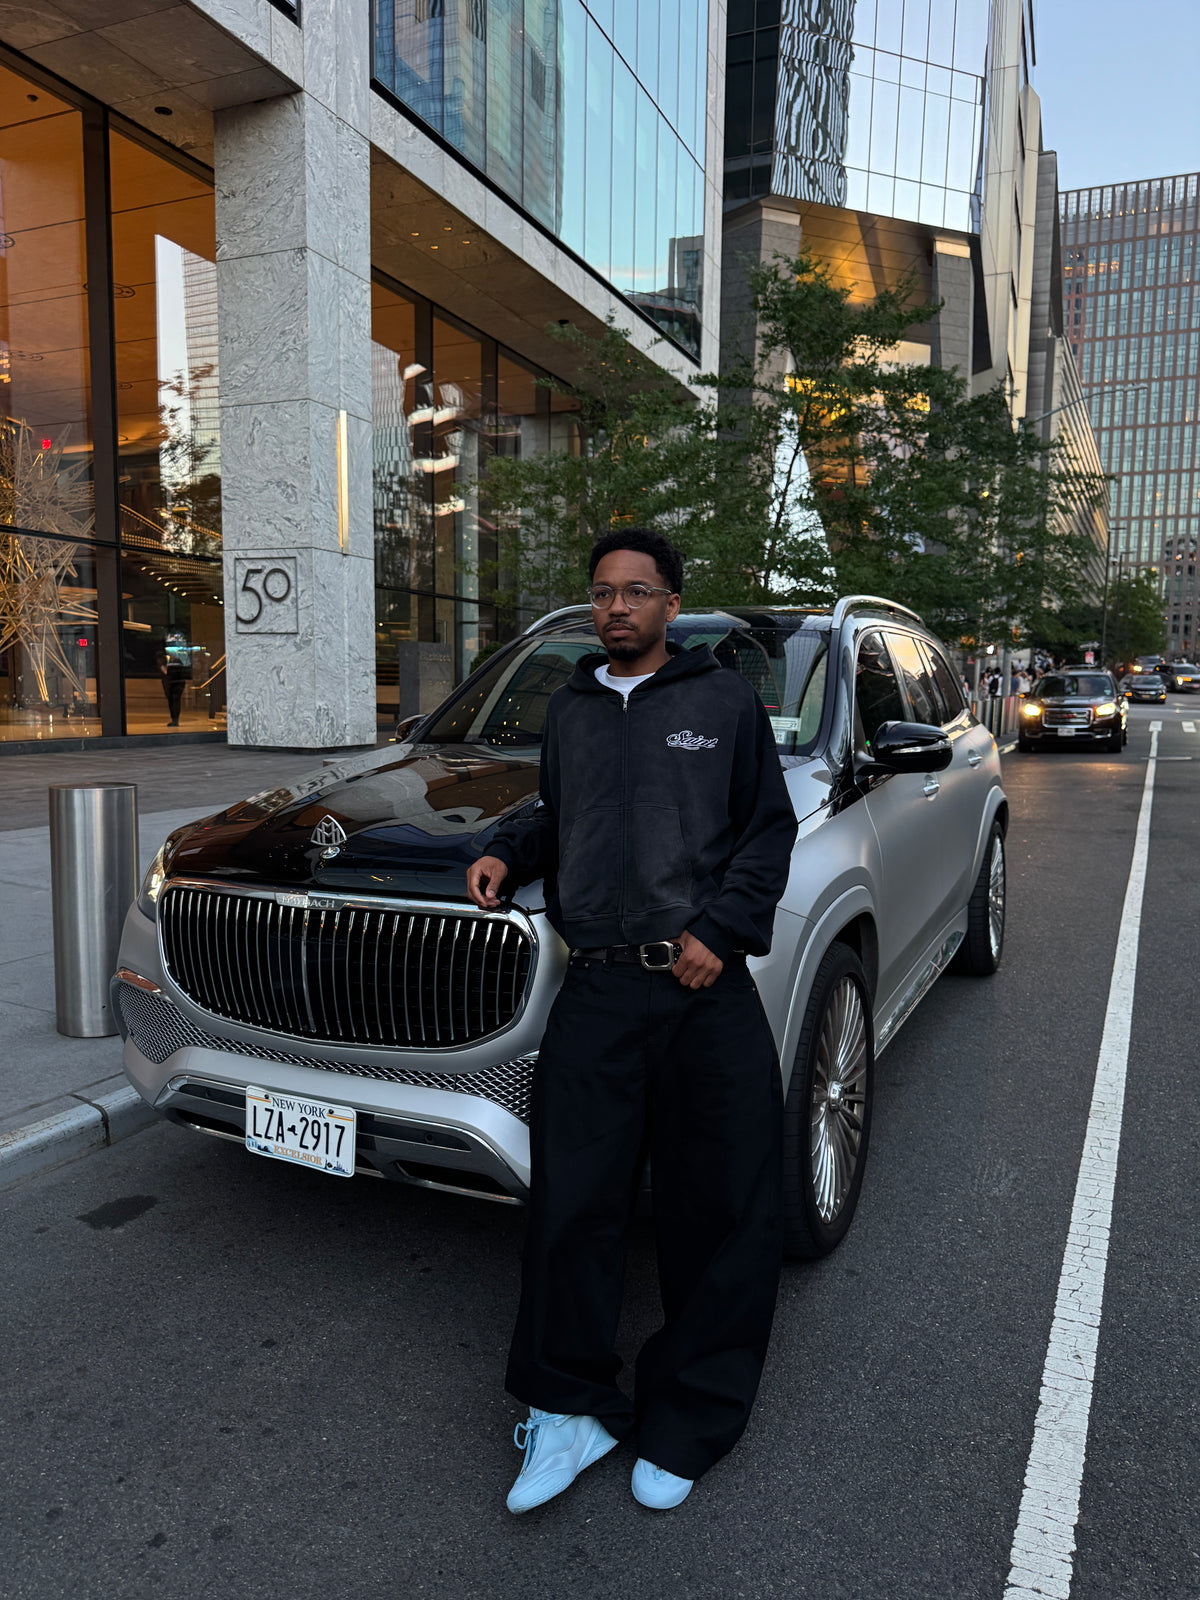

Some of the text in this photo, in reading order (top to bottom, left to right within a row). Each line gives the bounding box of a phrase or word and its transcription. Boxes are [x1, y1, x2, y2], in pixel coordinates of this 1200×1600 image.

[236, 568, 291, 624] 50
[666, 730, 719, 750] Saint
[272, 1097, 327, 1119] NEW YORK
[273, 1145, 323, 1165] EXCELSIOR
